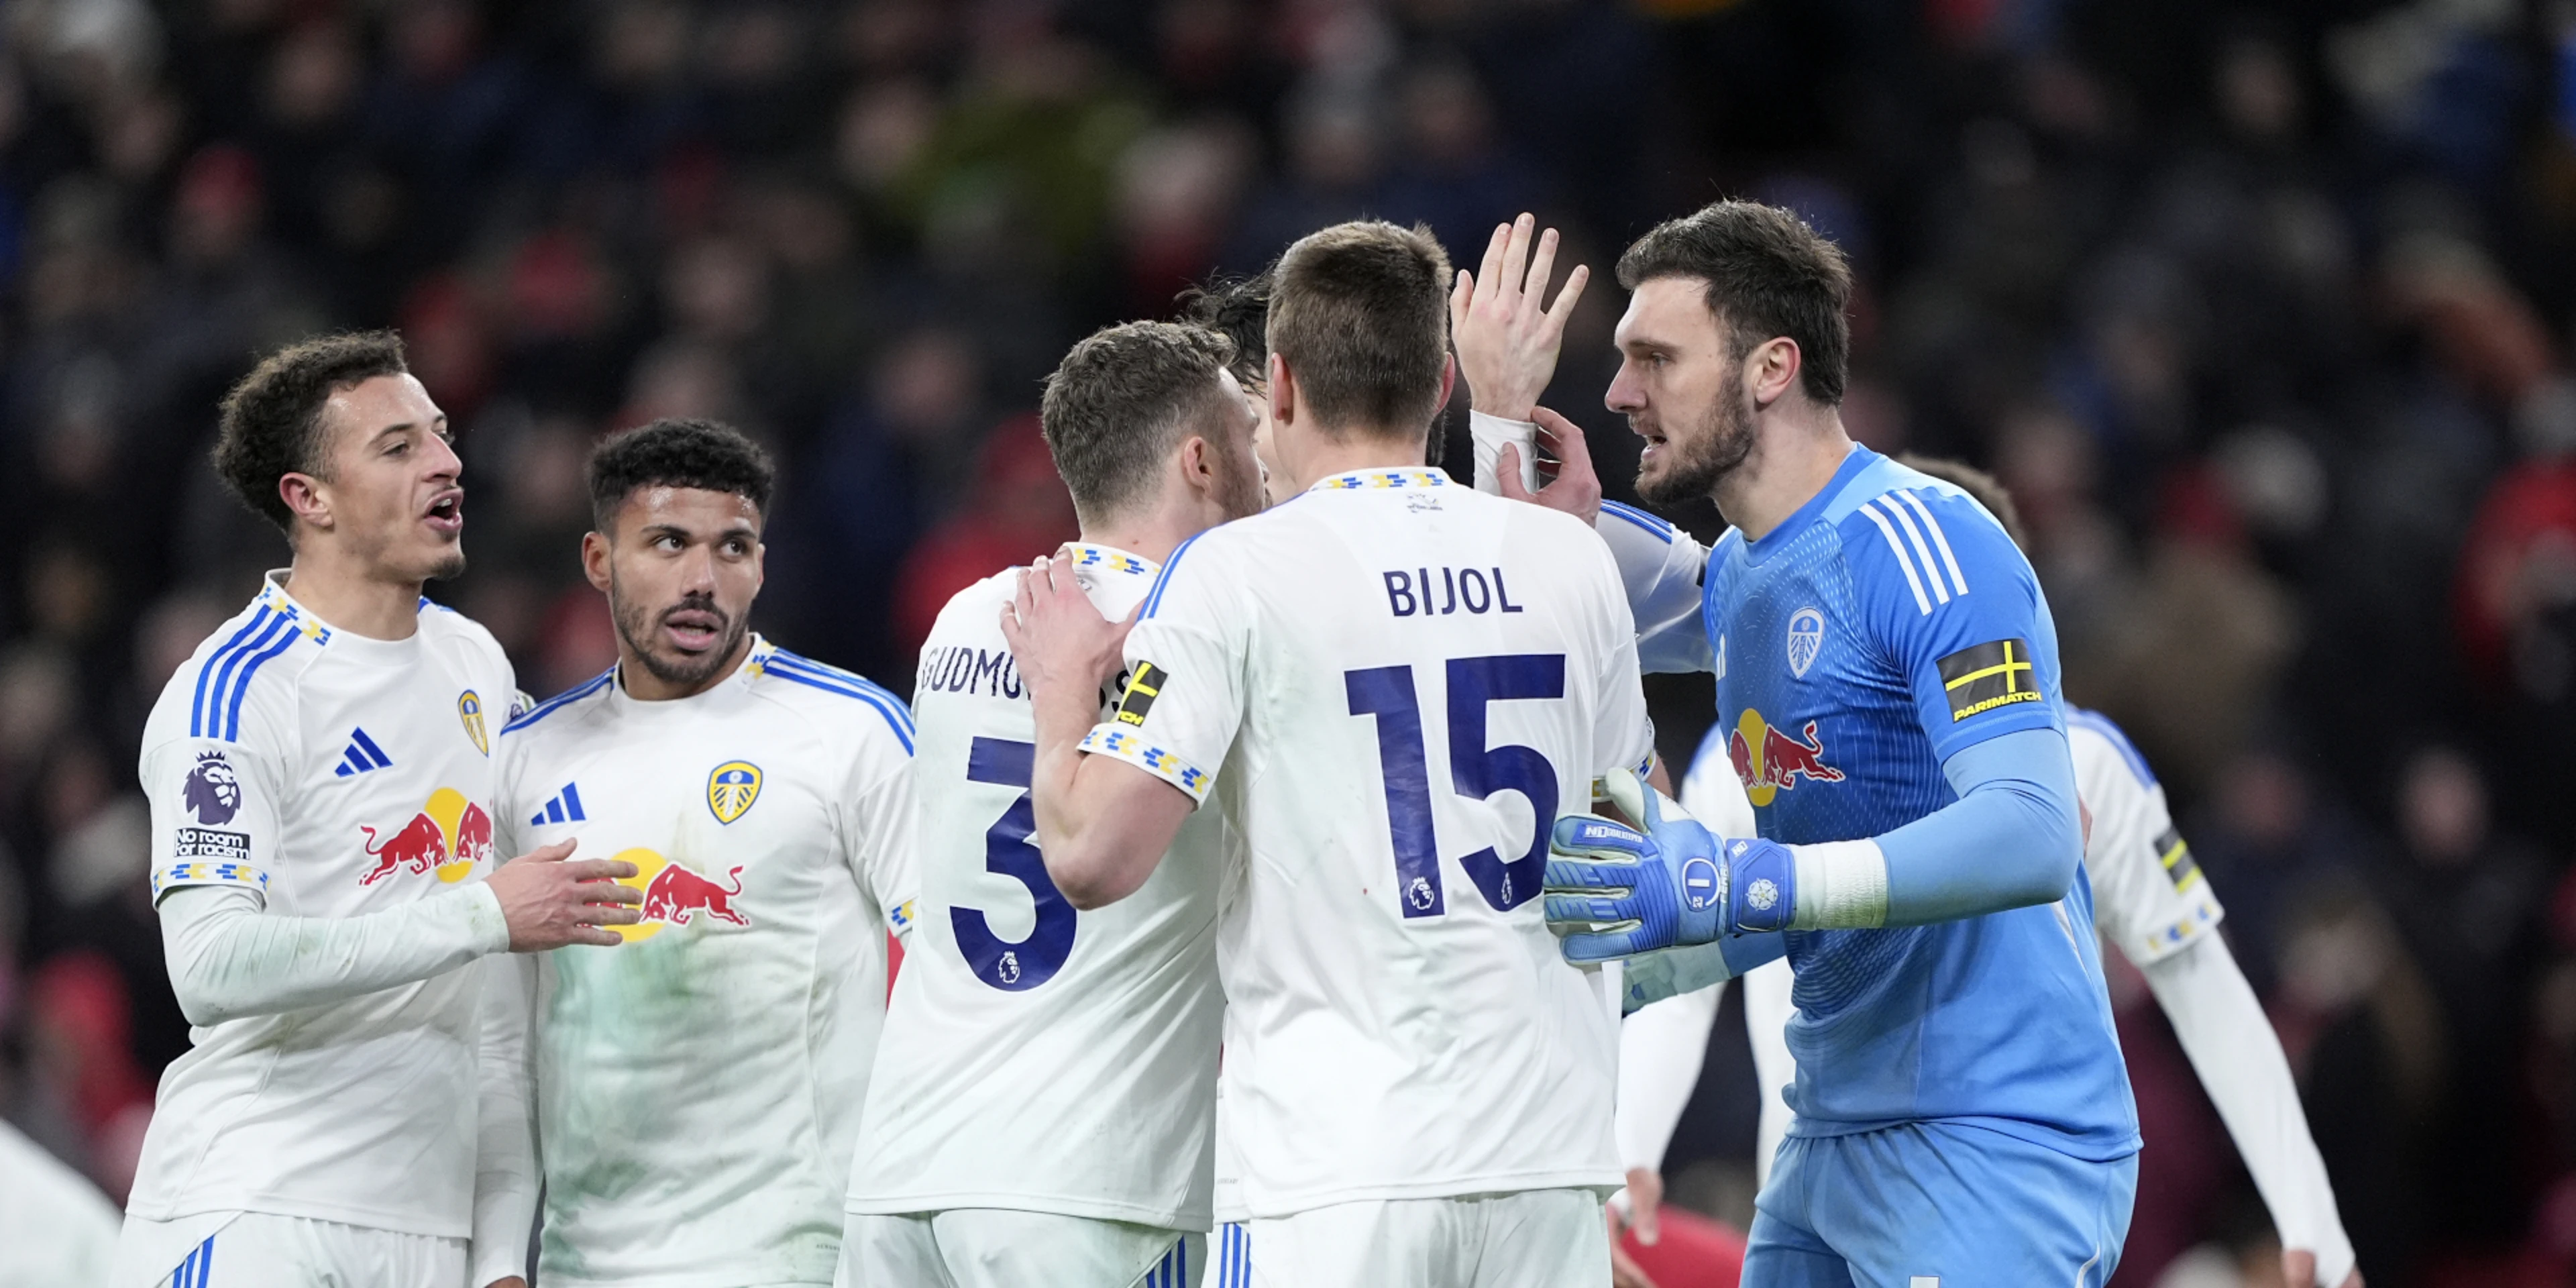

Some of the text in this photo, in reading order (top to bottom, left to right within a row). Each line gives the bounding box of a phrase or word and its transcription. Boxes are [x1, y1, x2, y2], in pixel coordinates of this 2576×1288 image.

[1383, 567, 1523, 616] BIJOL
[1953, 692, 2043, 722] PARIMATCH
[1344, 653, 1566, 919] 15
[176, 828, 243, 847] No room
[198, 843, 250, 859] racism
[949, 736, 1079, 992] 3
